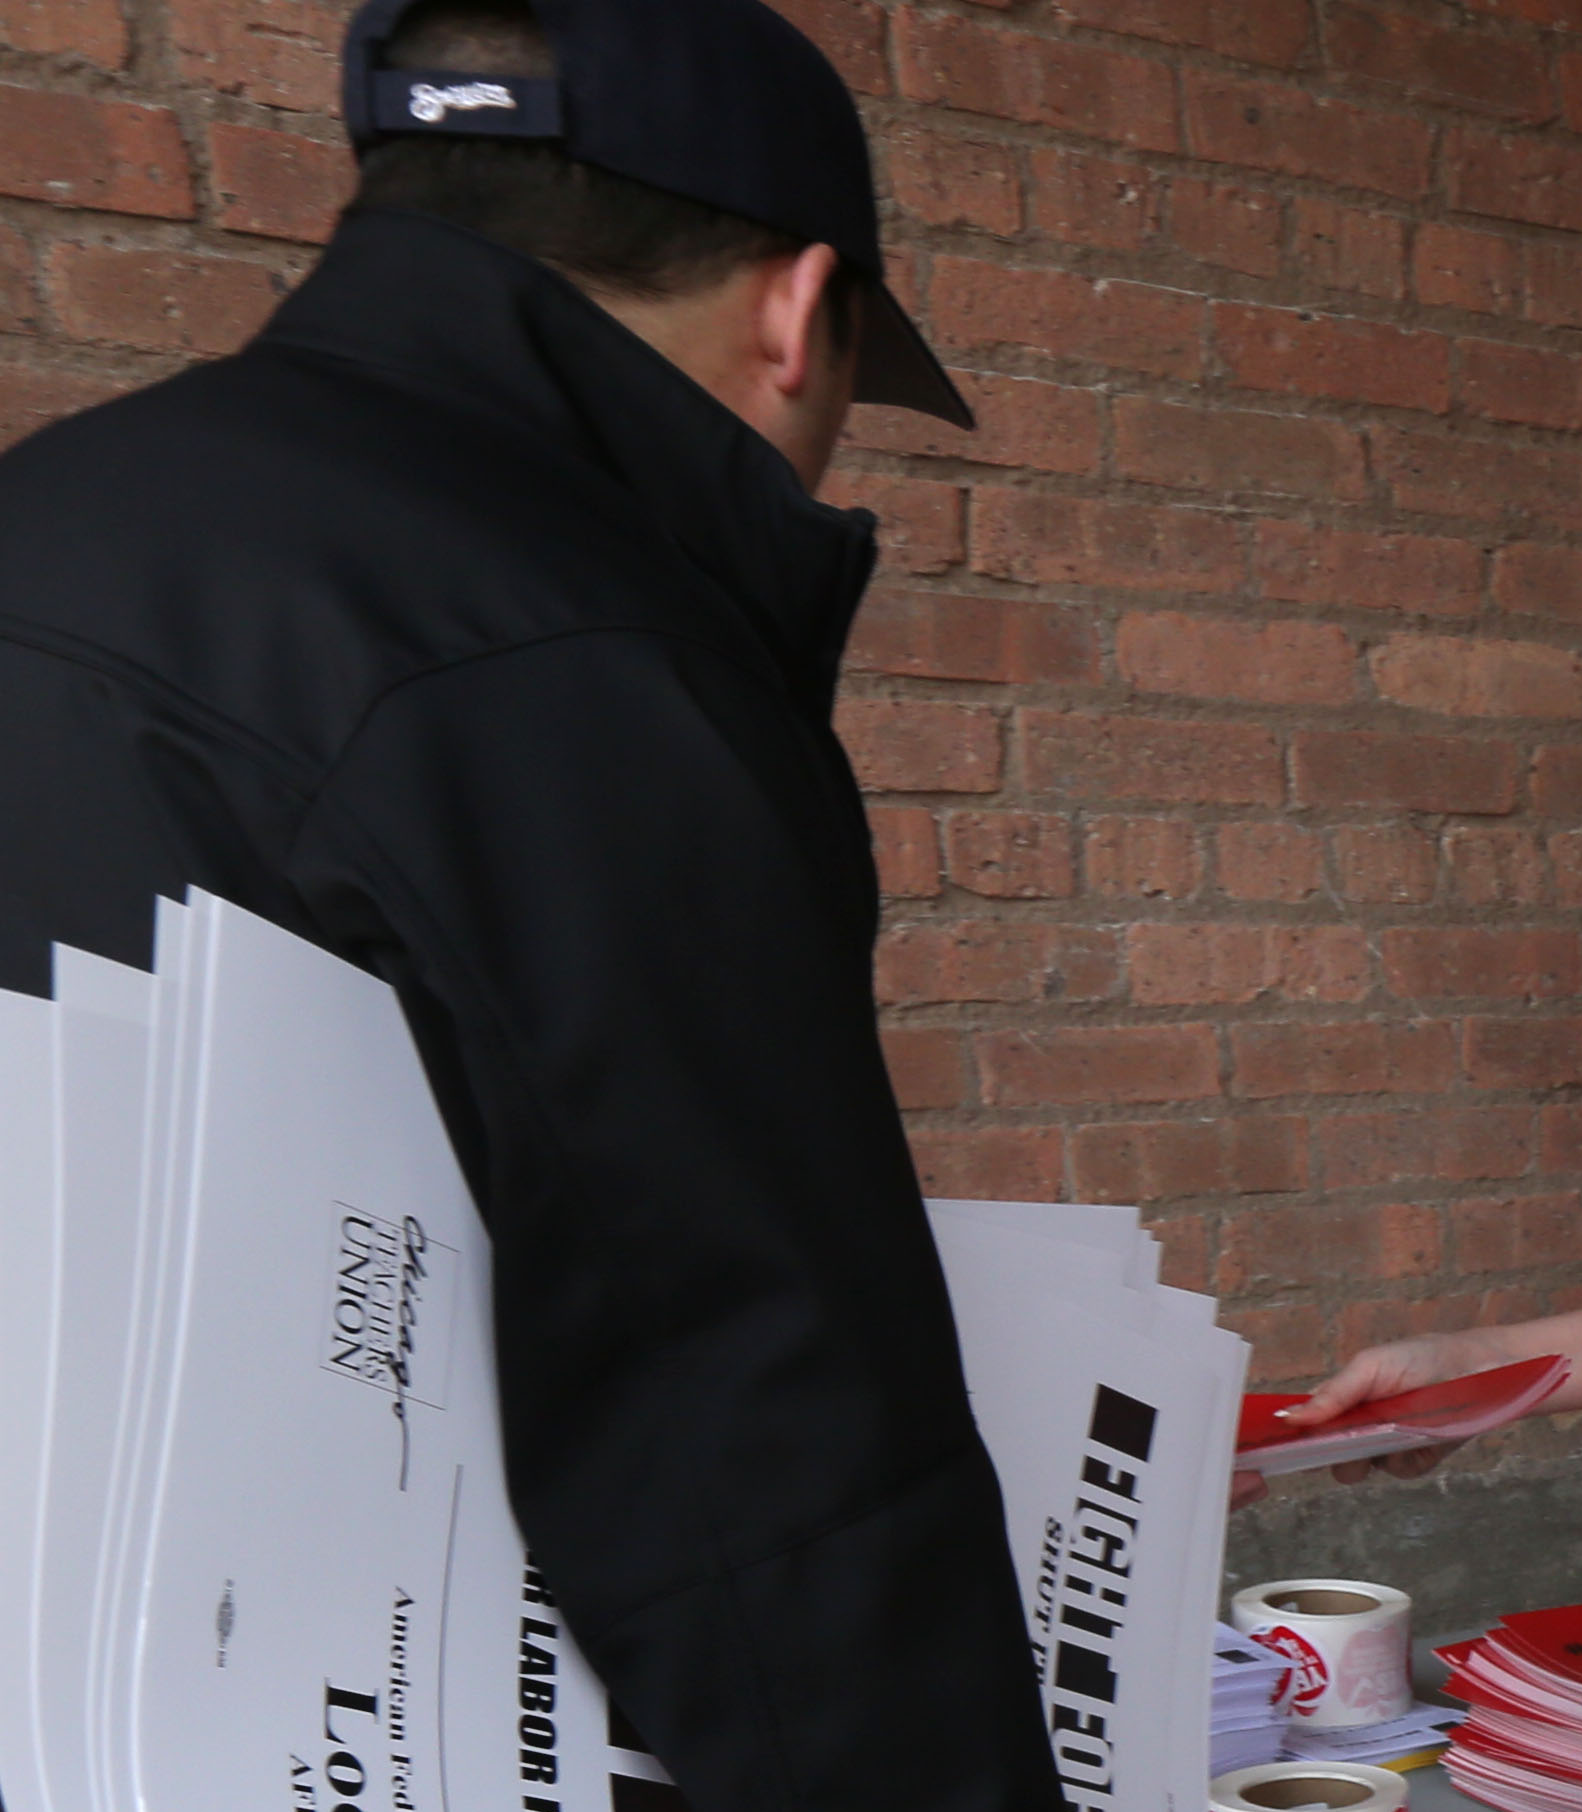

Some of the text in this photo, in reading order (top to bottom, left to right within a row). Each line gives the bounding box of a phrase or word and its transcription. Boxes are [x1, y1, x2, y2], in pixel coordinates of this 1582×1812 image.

[330, 1214, 374, 1372] UNION
[1036, 1514, 1063, 1632] SHUT
[1058, 1438, 1150, 1660] FIGHT
[388, 1585, 415, 1741] American
[518, 1616, 558, 1786] LABOR
